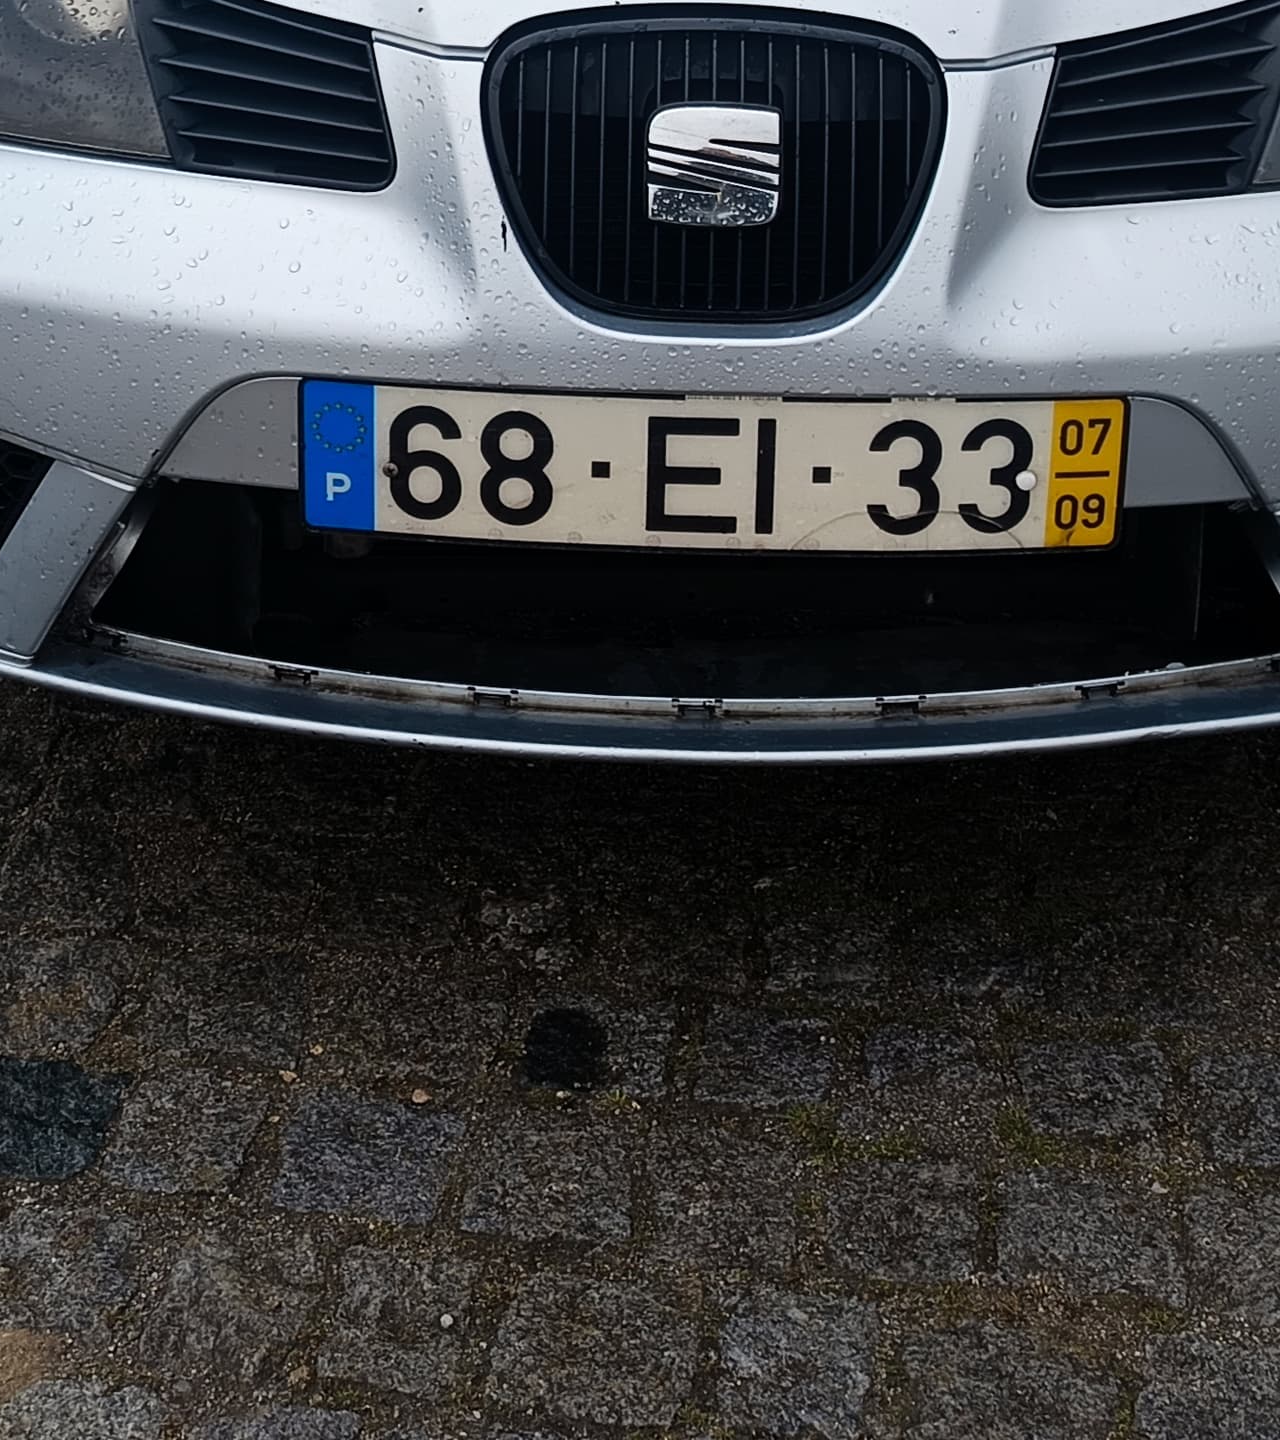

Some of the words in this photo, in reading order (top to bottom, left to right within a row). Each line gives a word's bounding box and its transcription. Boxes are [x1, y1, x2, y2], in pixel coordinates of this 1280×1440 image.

[1059, 418, 1112, 456] 07
[325, 471, 352, 501] P
[1054, 493, 1106, 530] 09
